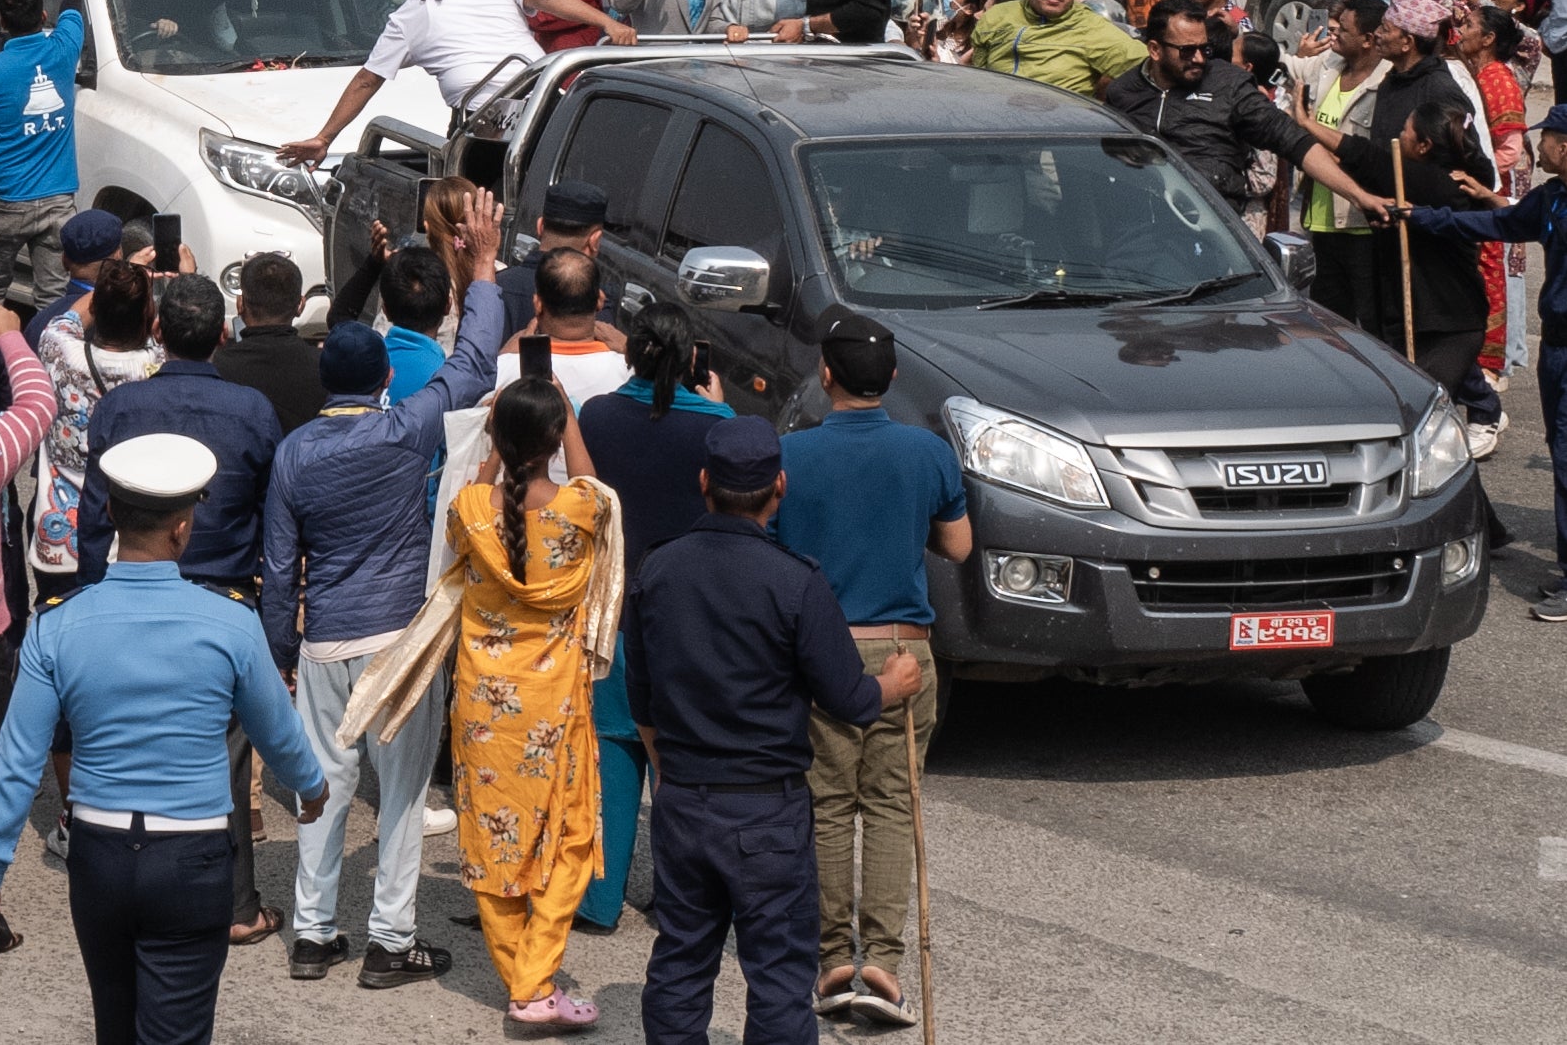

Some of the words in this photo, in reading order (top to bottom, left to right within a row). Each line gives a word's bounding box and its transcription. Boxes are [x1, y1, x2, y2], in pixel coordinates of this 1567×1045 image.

[24, 116, 65, 136] R.A.T.
[1227, 463, 1325, 485] ISUZU
[1259, 625, 1327, 641] ९११६
